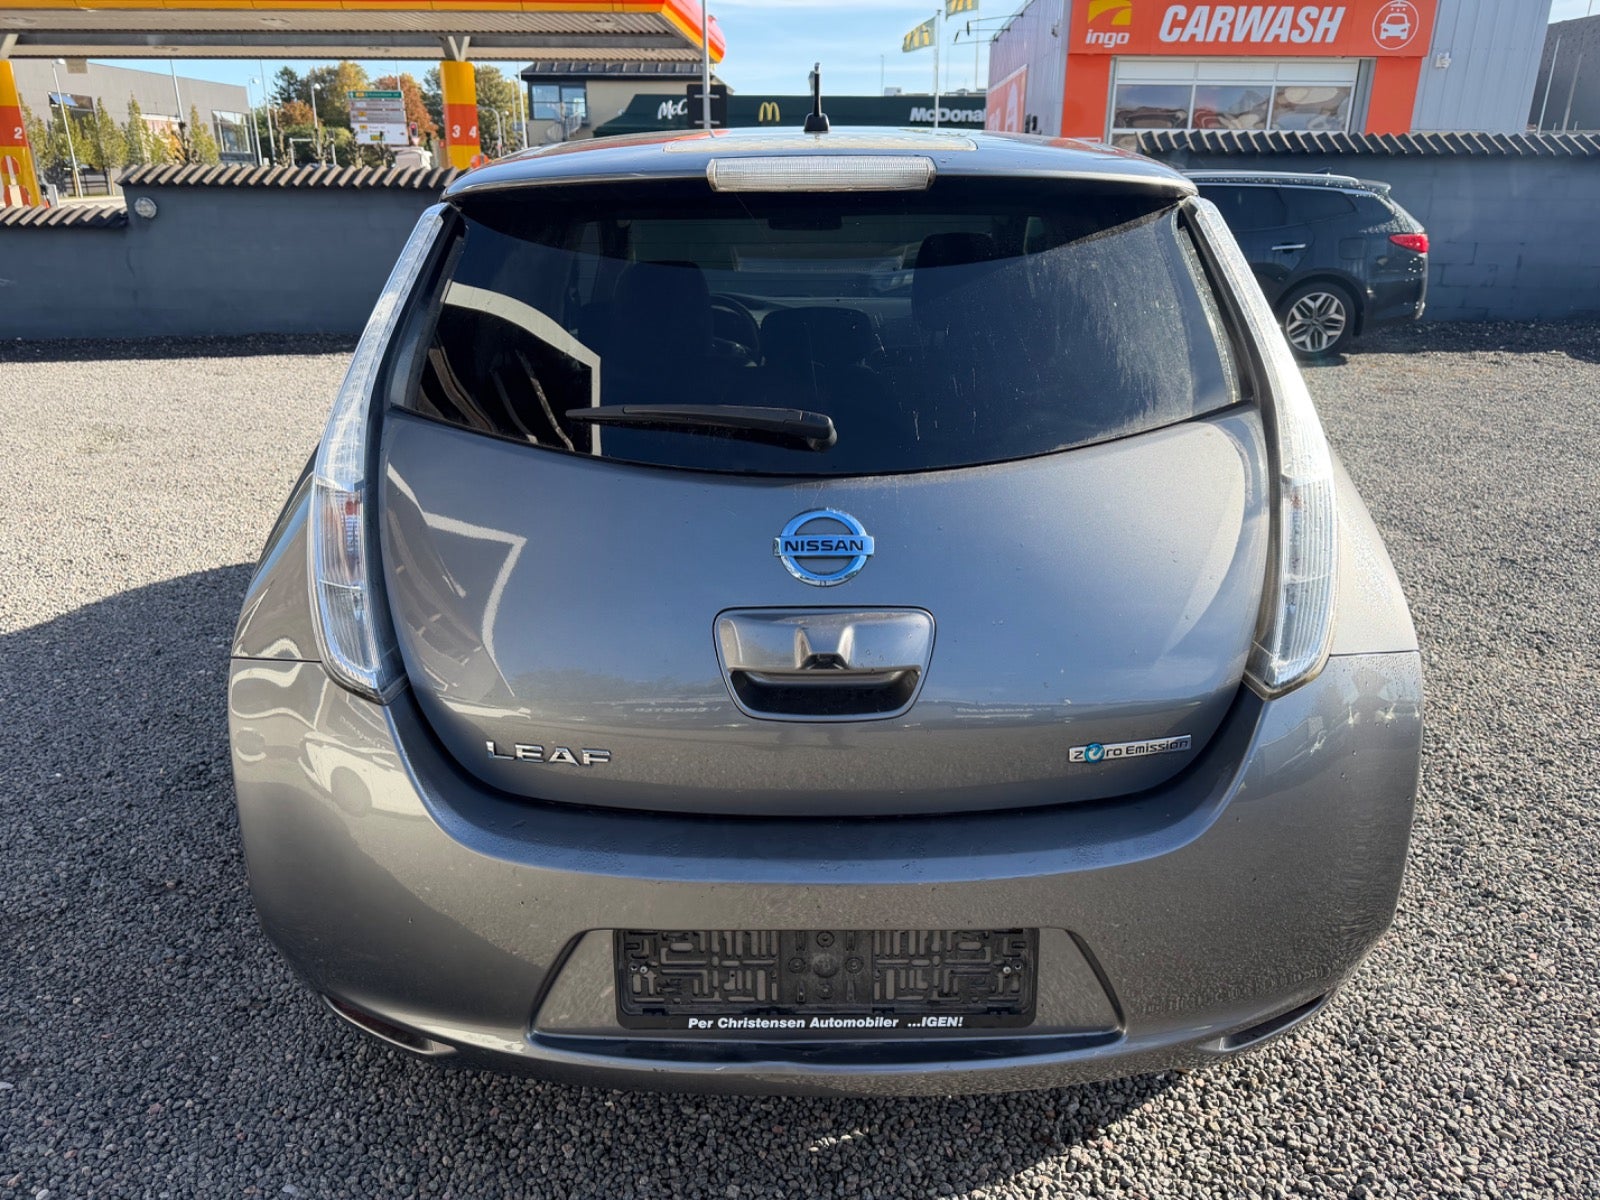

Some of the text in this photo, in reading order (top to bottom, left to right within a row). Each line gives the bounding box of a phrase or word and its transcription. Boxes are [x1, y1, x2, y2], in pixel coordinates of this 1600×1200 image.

[1159, 5, 1346, 43] CARWASH
[1085, 29, 1130, 48] ingo
[13, 126, 23, 139] 2
[452, 124, 477, 139] 3 4
[784, 539, 864, 552] NISSAN
[485, 740, 611, 766] LEAF
[1125, 739, 1189, 755] Emission
[688, 1017, 714, 1029] Per
[717, 1016, 806, 1029] Christensen
[809, 1016, 899, 1028] Automobiler
